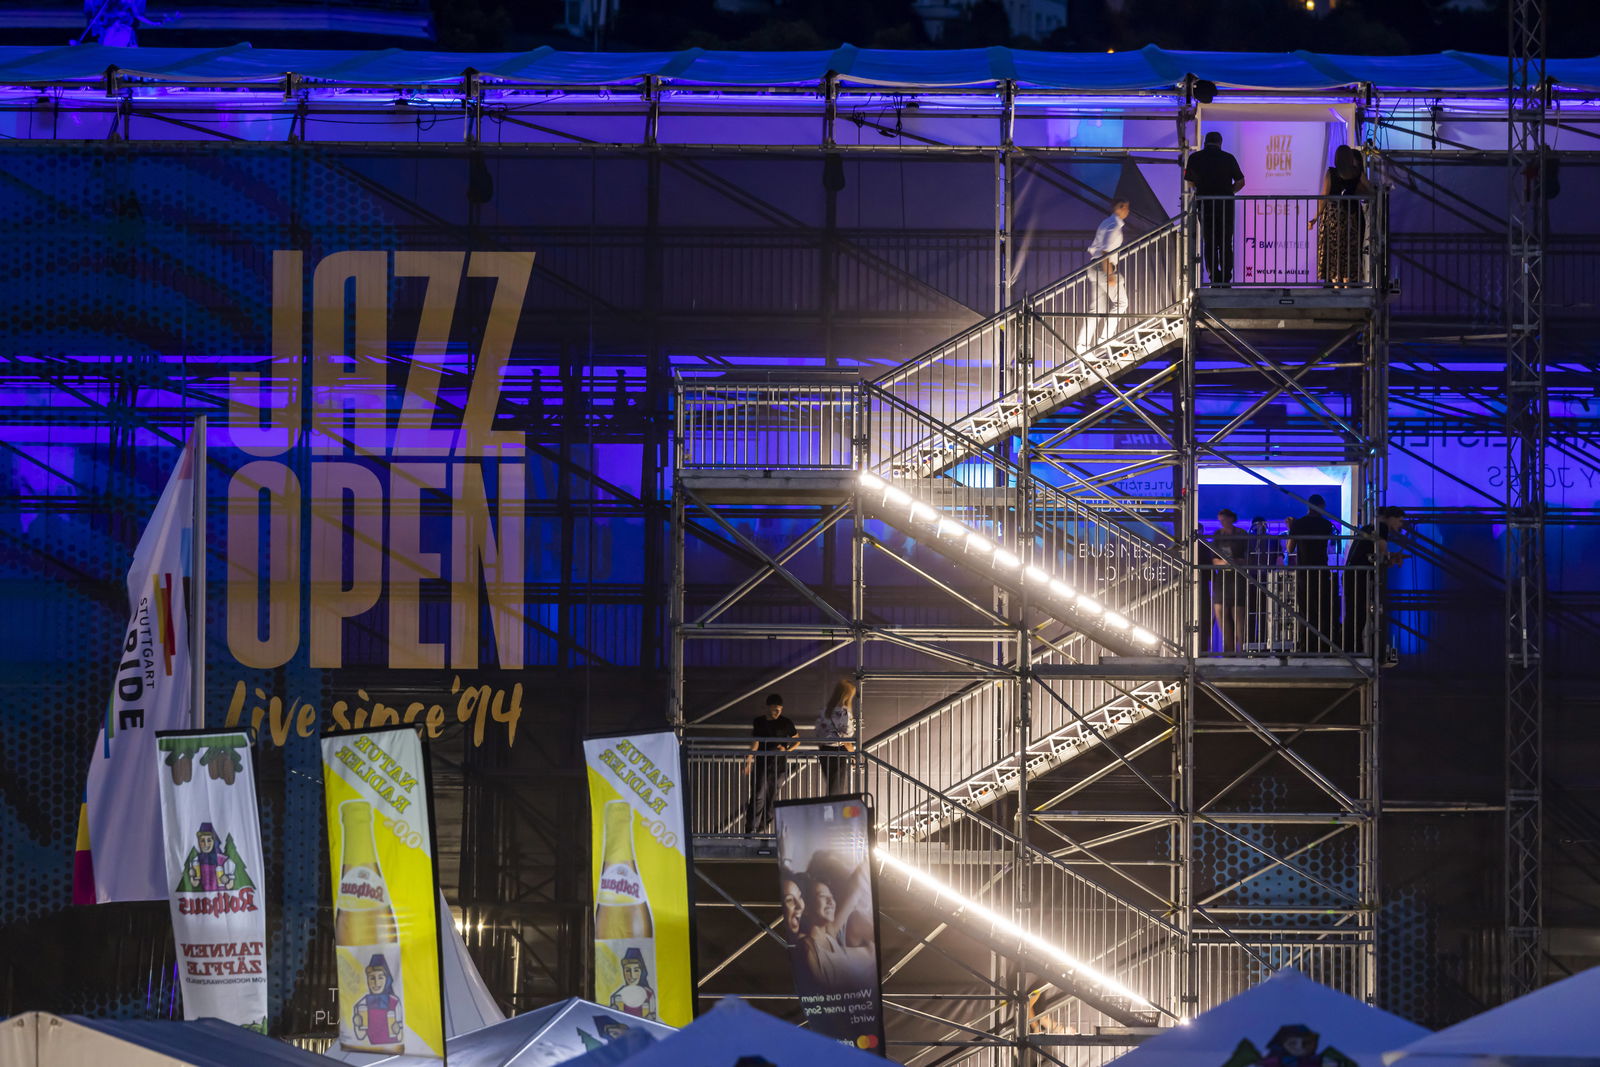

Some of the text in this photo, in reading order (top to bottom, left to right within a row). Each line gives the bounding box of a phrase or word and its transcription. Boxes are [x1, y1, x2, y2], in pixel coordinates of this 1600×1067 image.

[1266, 135, 1293, 152] JAZZ
[1266, 153, 1292, 170] OPEN
[228, 249, 536, 457] JAZZ
[226, 460, 526, 670] OPEN
[1079, 543, 1167, 559] BUSNES
[118, 604, 145, 731] RIDE
[140, 597, 155, 689] STUTTGART
